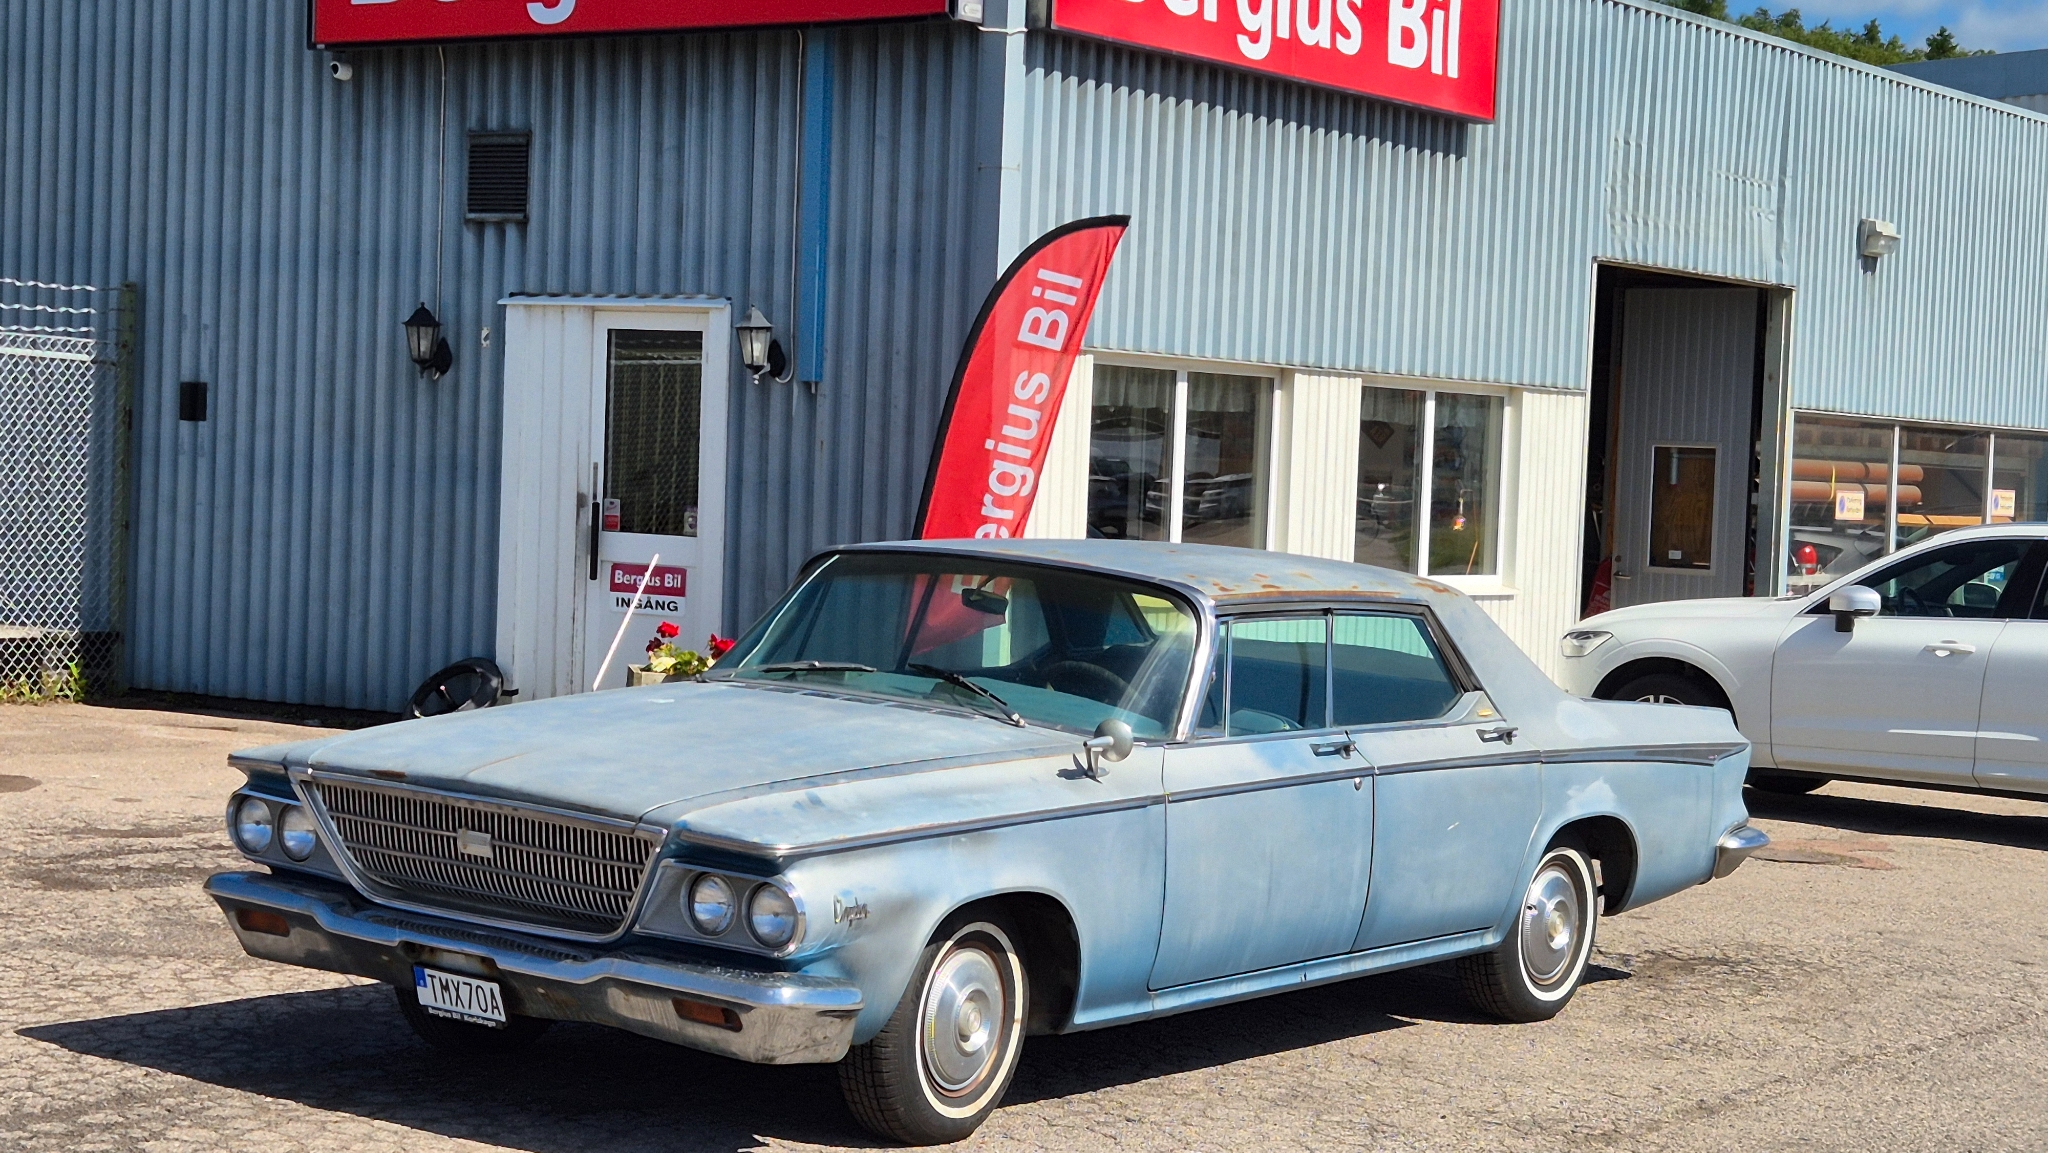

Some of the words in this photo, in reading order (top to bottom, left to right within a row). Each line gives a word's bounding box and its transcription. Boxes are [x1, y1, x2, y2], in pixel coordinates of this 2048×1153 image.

[1388, 0, 1461, 78] Bil
[1017, 267, 1083, 352] Bil
[664, 573, 682, 588] Bil
[427, 974, 503, 1017] TMX70A
